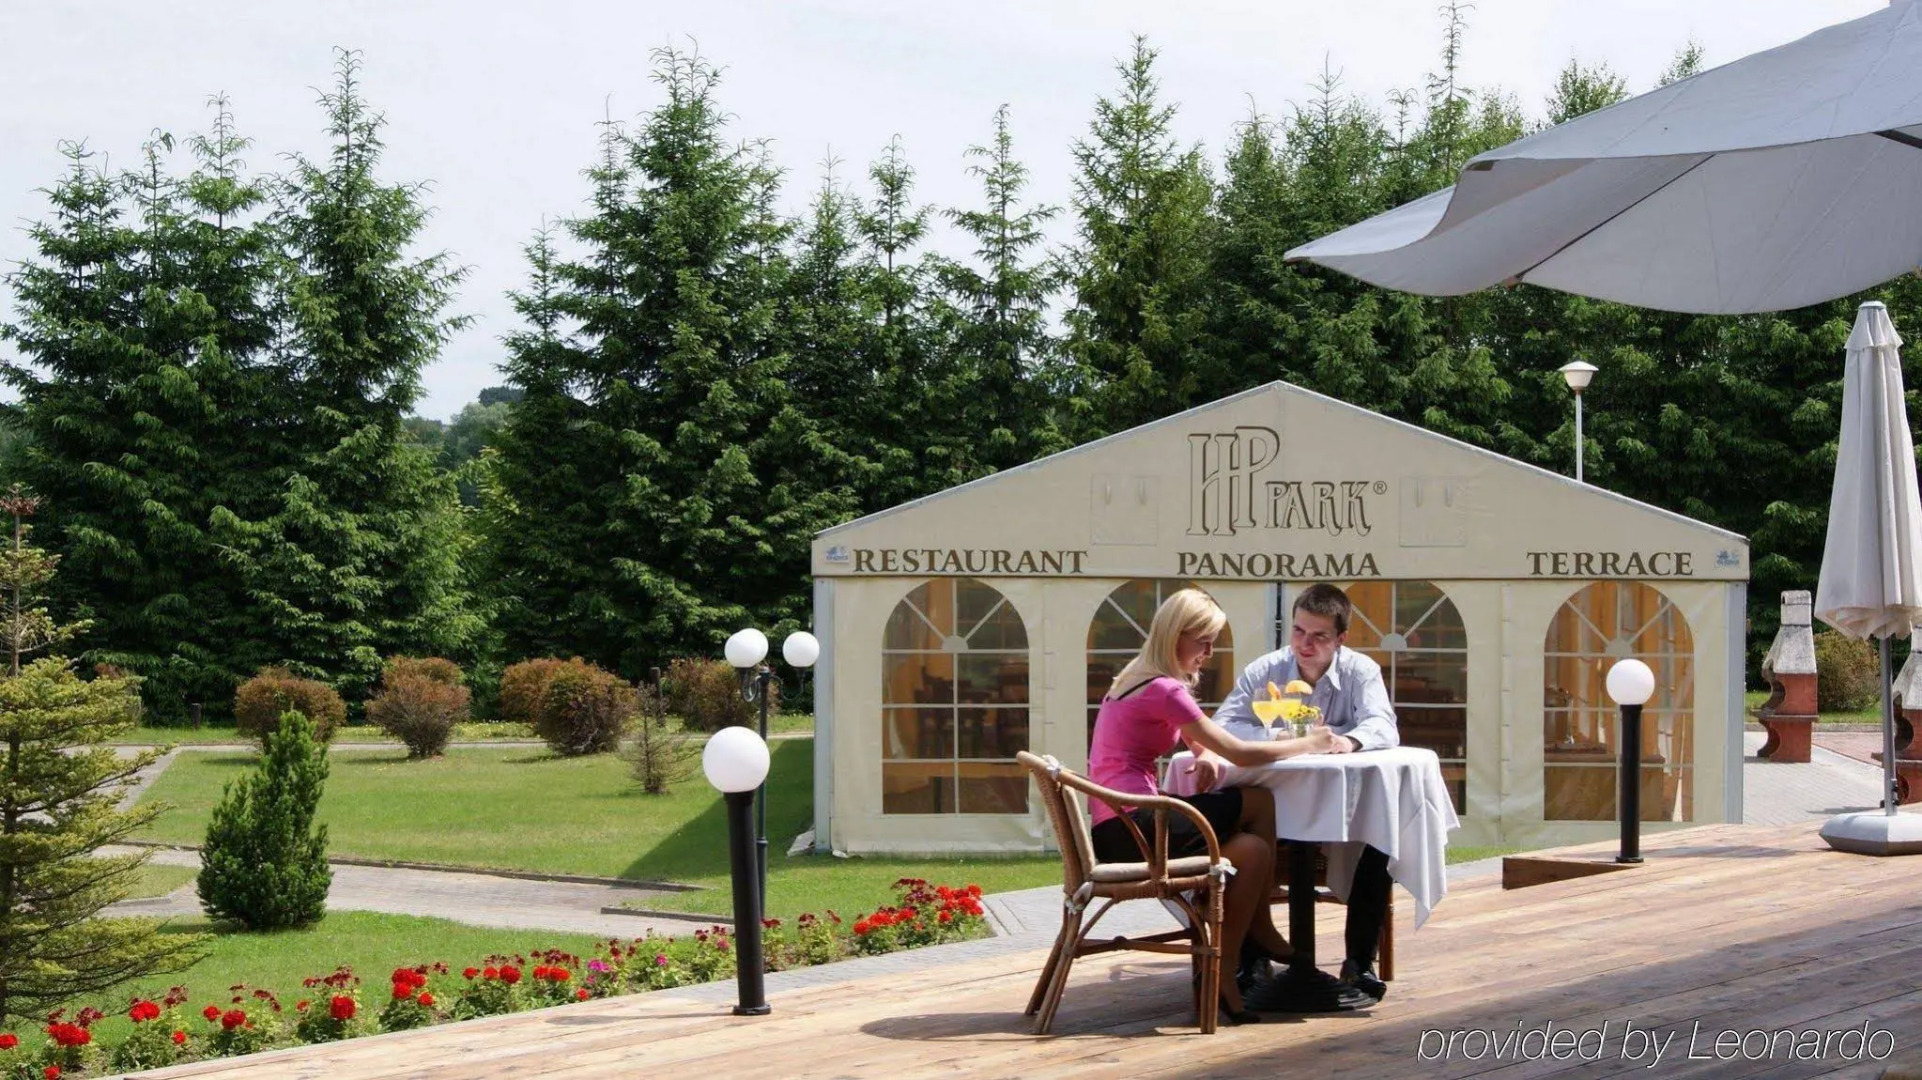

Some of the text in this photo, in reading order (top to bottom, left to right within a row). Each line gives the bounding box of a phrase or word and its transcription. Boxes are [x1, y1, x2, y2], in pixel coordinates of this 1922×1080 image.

[852, 548, 1694, 578] RESTAURANT PANORAMA TERRACE
